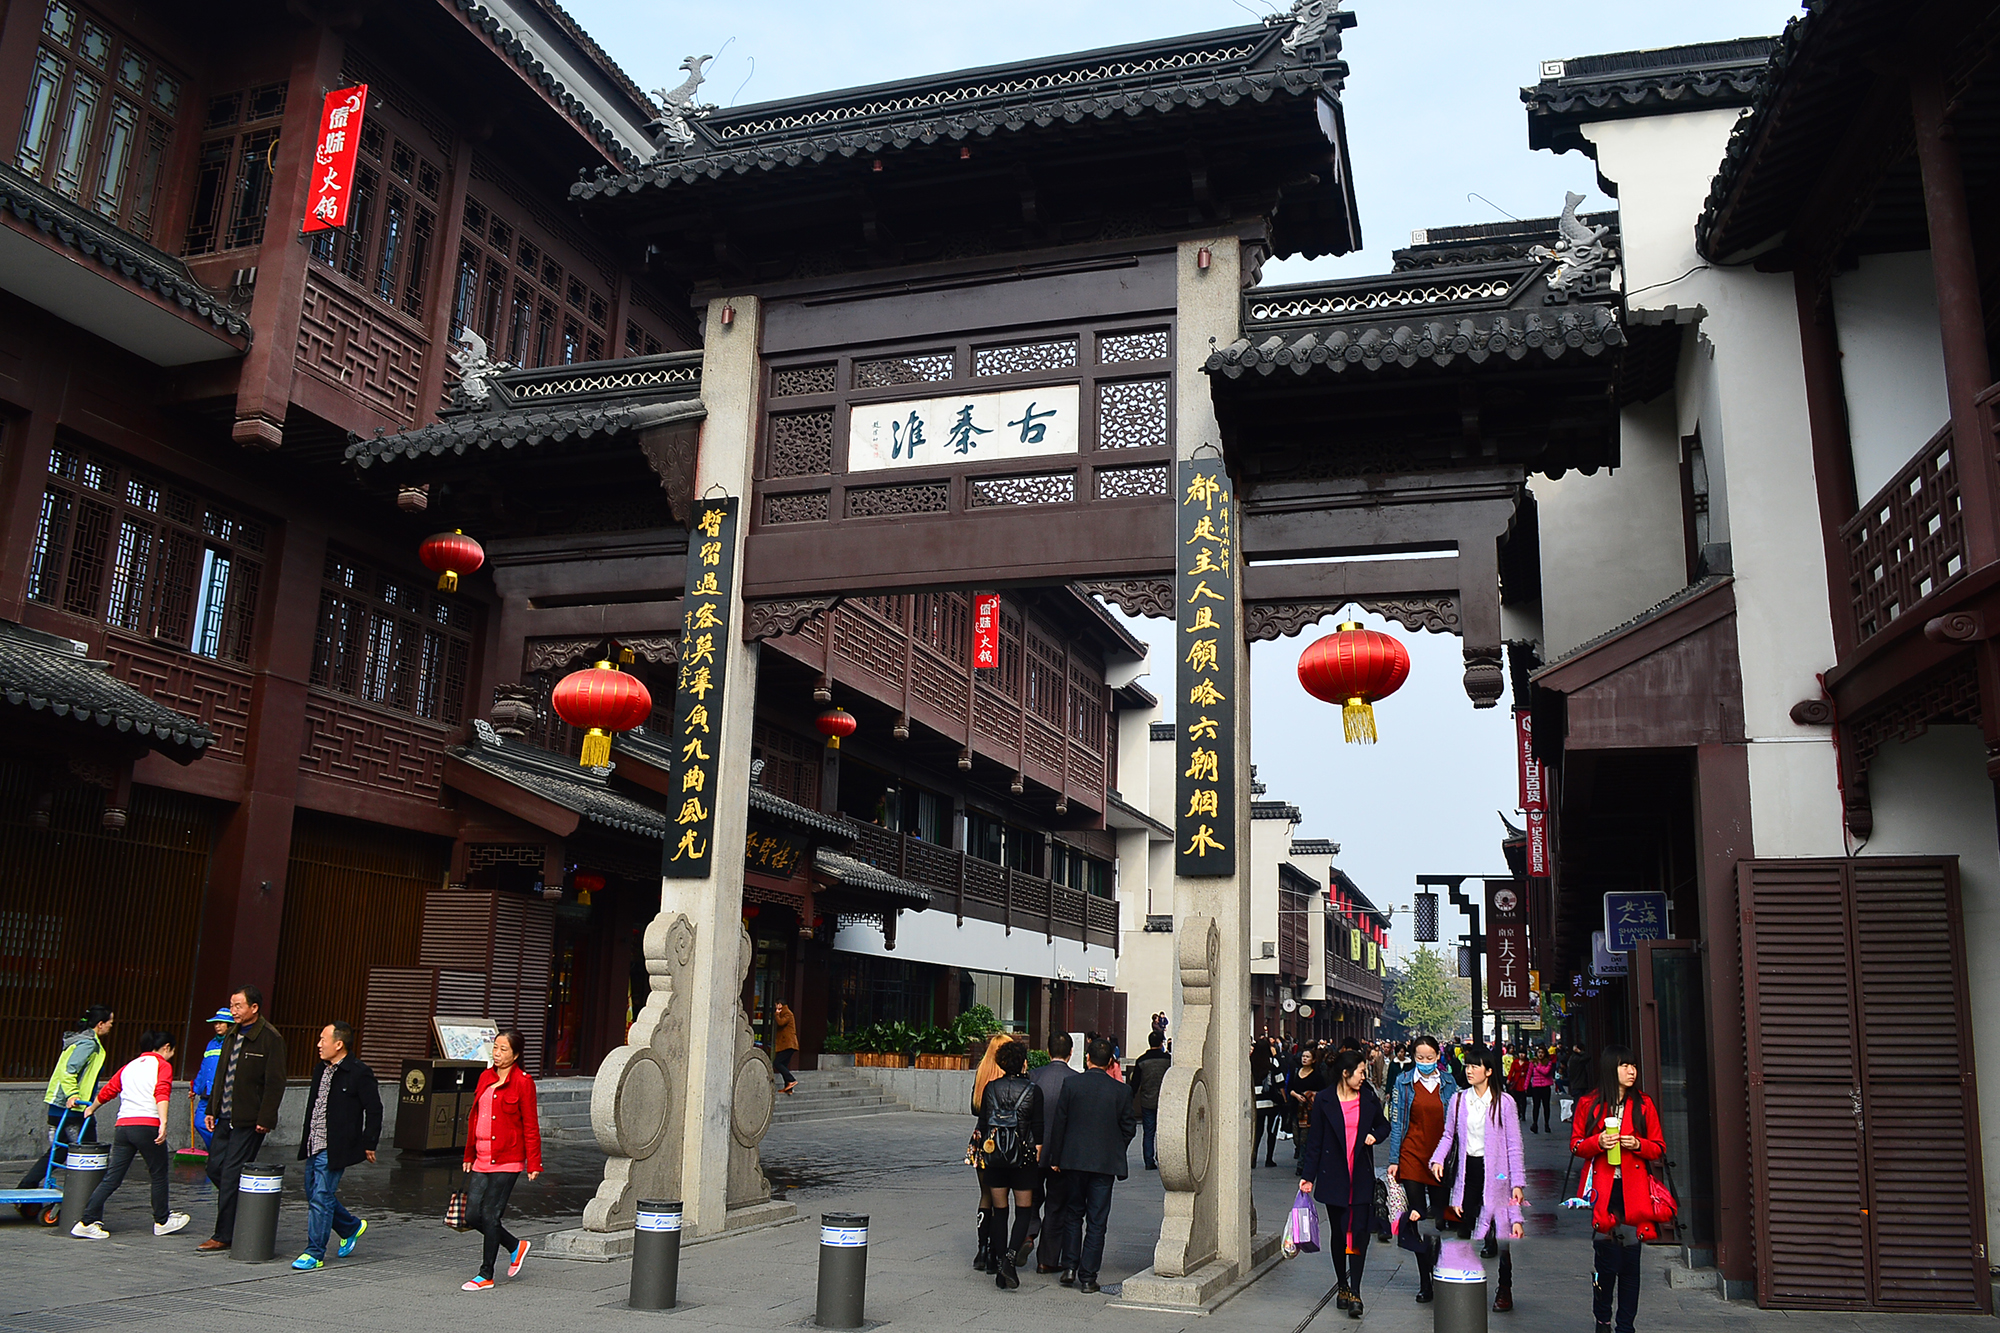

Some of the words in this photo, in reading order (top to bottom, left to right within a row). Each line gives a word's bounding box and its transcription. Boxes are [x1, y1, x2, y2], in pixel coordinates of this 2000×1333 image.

[312, 105, 350, 220] 傣妹火锅
[892, 402, 1057, 459] 古秦淮
[1498, 928, 1515, 937] 南京
[1498, 938, 1517, 999] 夫子庙
